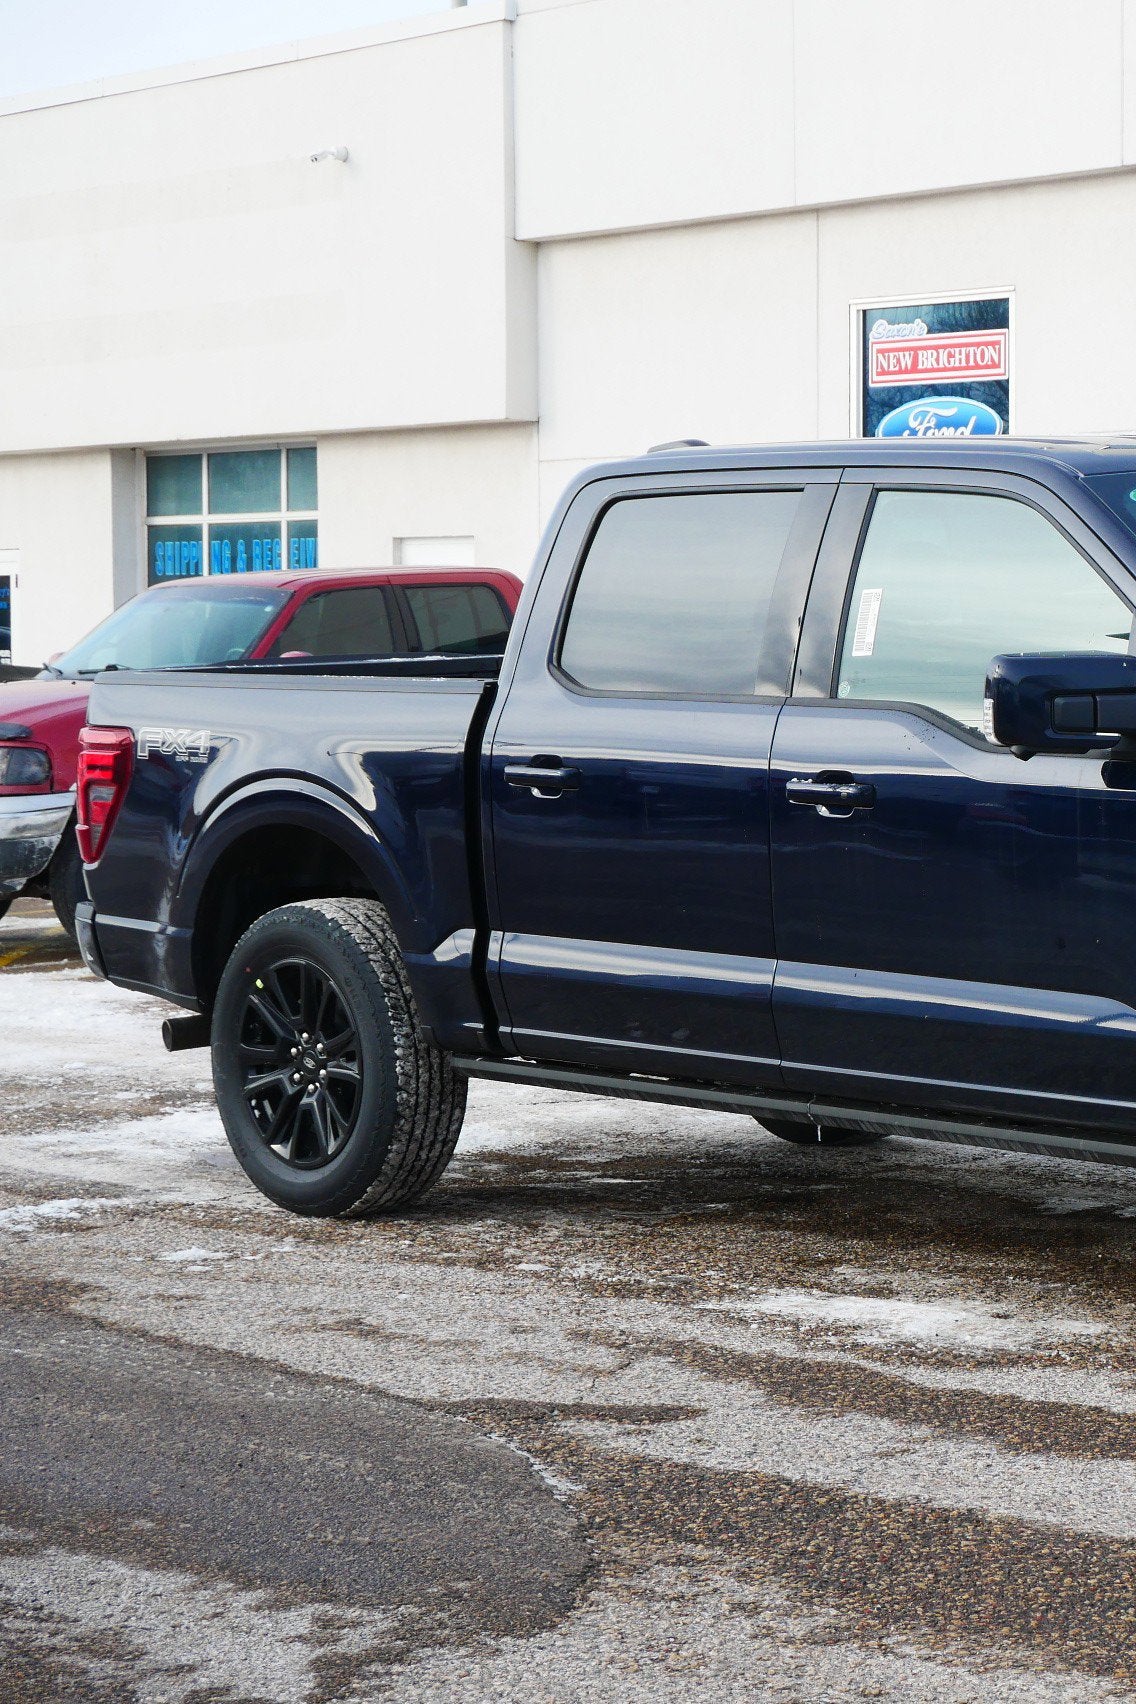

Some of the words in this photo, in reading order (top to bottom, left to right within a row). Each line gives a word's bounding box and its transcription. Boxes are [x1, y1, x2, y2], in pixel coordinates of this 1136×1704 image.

[870, 319, 927, 340] Saxon's
[877, 351, 914, 372] NEW
[917, 344, 1000, 369] BRIGHTON
[137, 727, 210, 759] FX4
